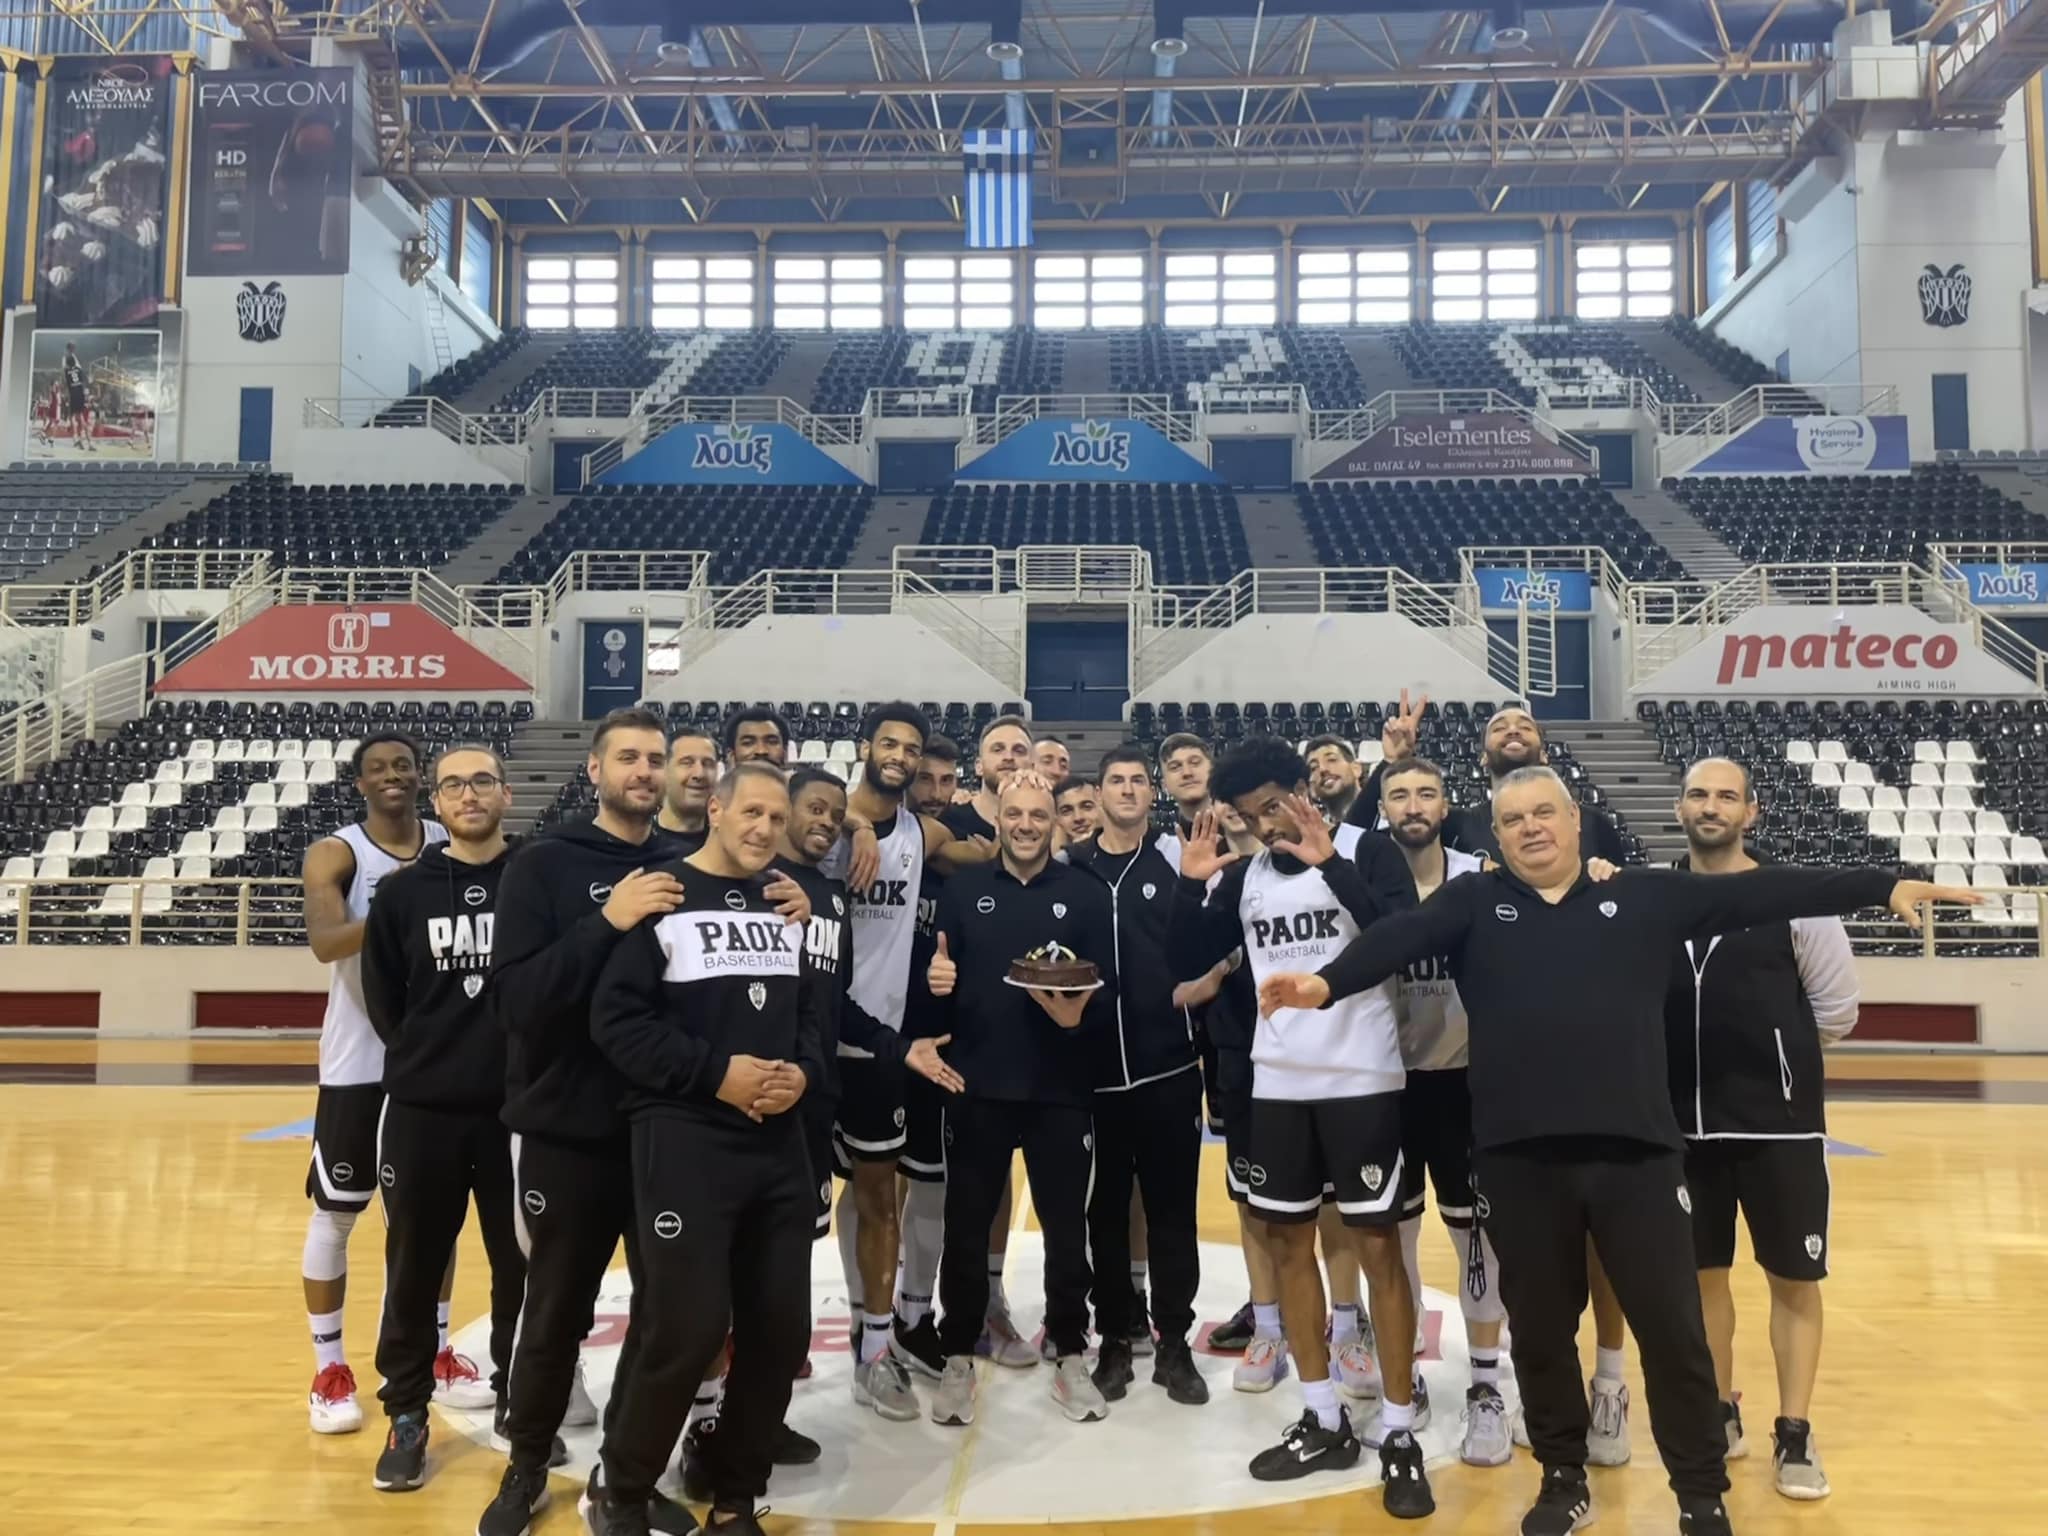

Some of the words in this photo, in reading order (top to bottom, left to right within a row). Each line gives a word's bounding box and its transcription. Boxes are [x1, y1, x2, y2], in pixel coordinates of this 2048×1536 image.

[199, 80, 346, 108] FARCOM
[216, 150, 247, 166] HD
[1389, 425, 1531, 448] Tselementes
[1810, 428, 1857, 437] Hygiene
[1821, 440, 1863, 448] Service
[249, 654, 446, 681] MORRIS
[1716, 626, 1958, 685] mateco
[1877, 680, 1921, 690] AIMING
[1928, 679, 1957, 690] HIGH
[847, 880, 908, 906] AOK
[428, 912, 495, 958] PAO
[695, 921, 792, 954] PAOK
[806, 915, 841, 961] OK
[1252, 908, 1339, 948] PAOK
[704, 955, 795, 969] BASKETBALL
[1268, 944, 1327, 962] BASKETBALL
